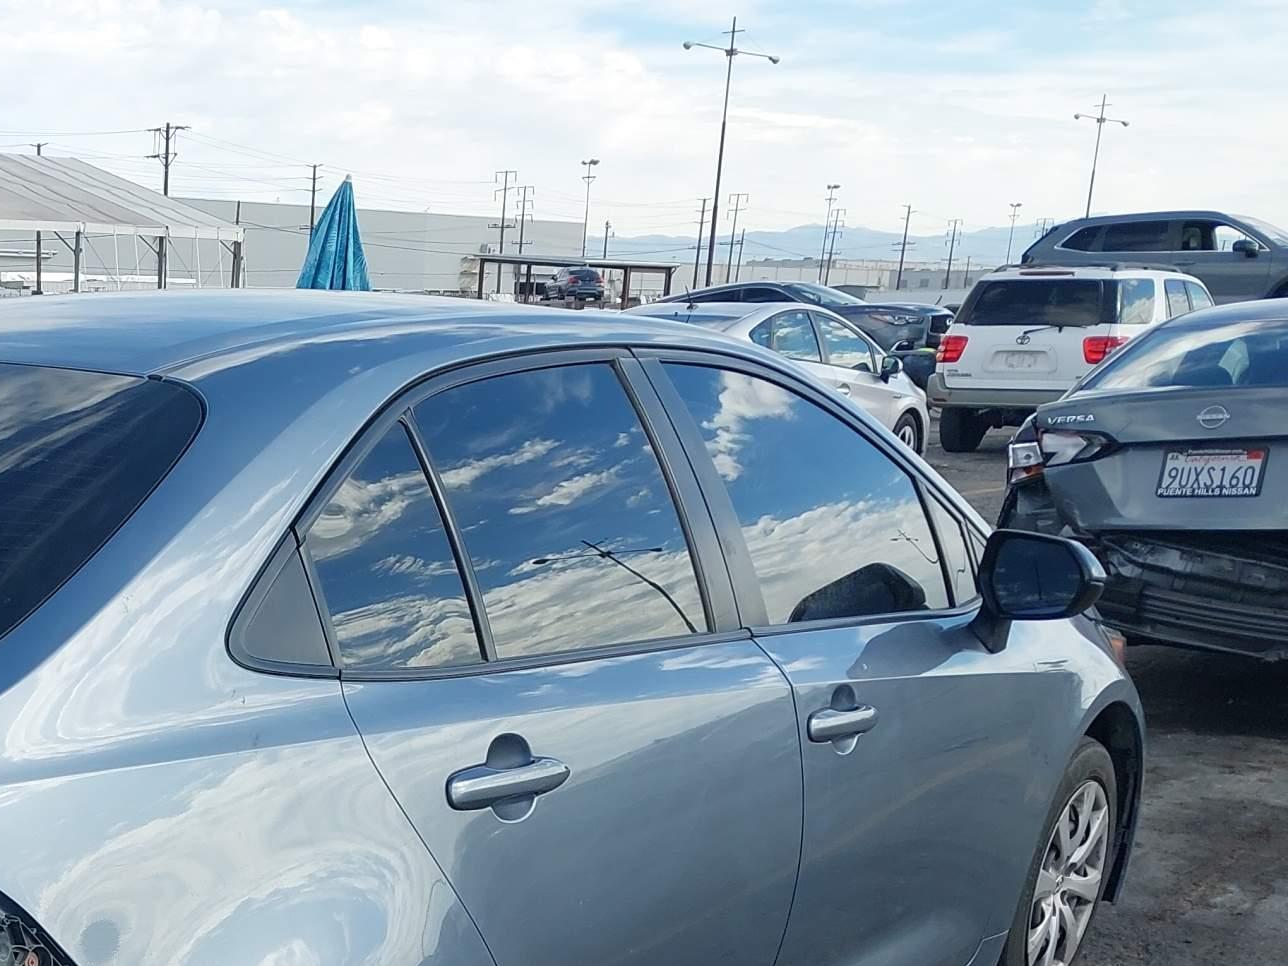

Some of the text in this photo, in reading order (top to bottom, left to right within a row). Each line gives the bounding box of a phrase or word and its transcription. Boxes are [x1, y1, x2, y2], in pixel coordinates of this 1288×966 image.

[1047, 414, 1095, 425] VERSA
[1165, 466, 1256, 488] 9UXS160
[1157, 487, 1257, 496] PUENTE HILLS NISSAN
